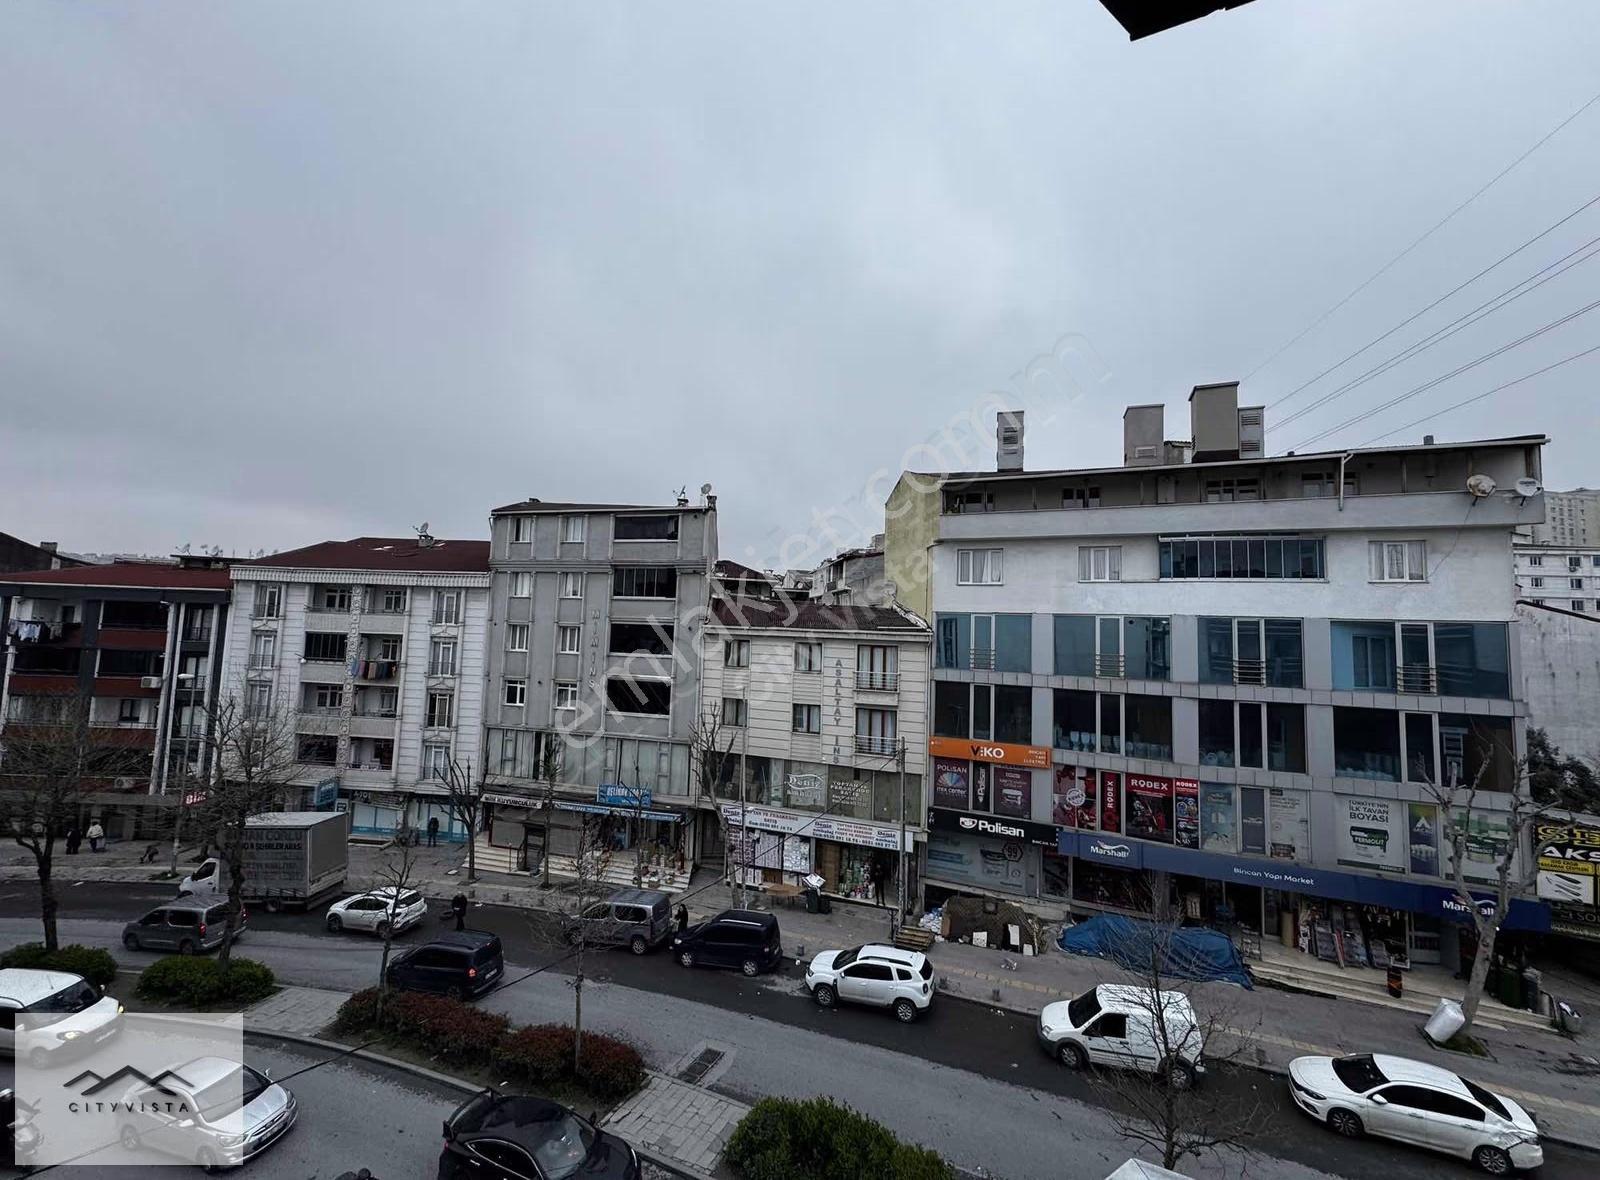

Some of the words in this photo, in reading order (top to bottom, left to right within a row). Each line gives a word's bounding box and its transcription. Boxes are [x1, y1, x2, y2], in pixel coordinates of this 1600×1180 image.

[1130, 779, 1169, 791] RODEX
[1107, 780, 1115, 809] RODEX
[1349, 811, 1389, 823] BOYASI
[978, 819, 1026, 839] Polisan
[1283, 874, 1315, 886] Market
[1442, 900, 1495, 916] Marsall
